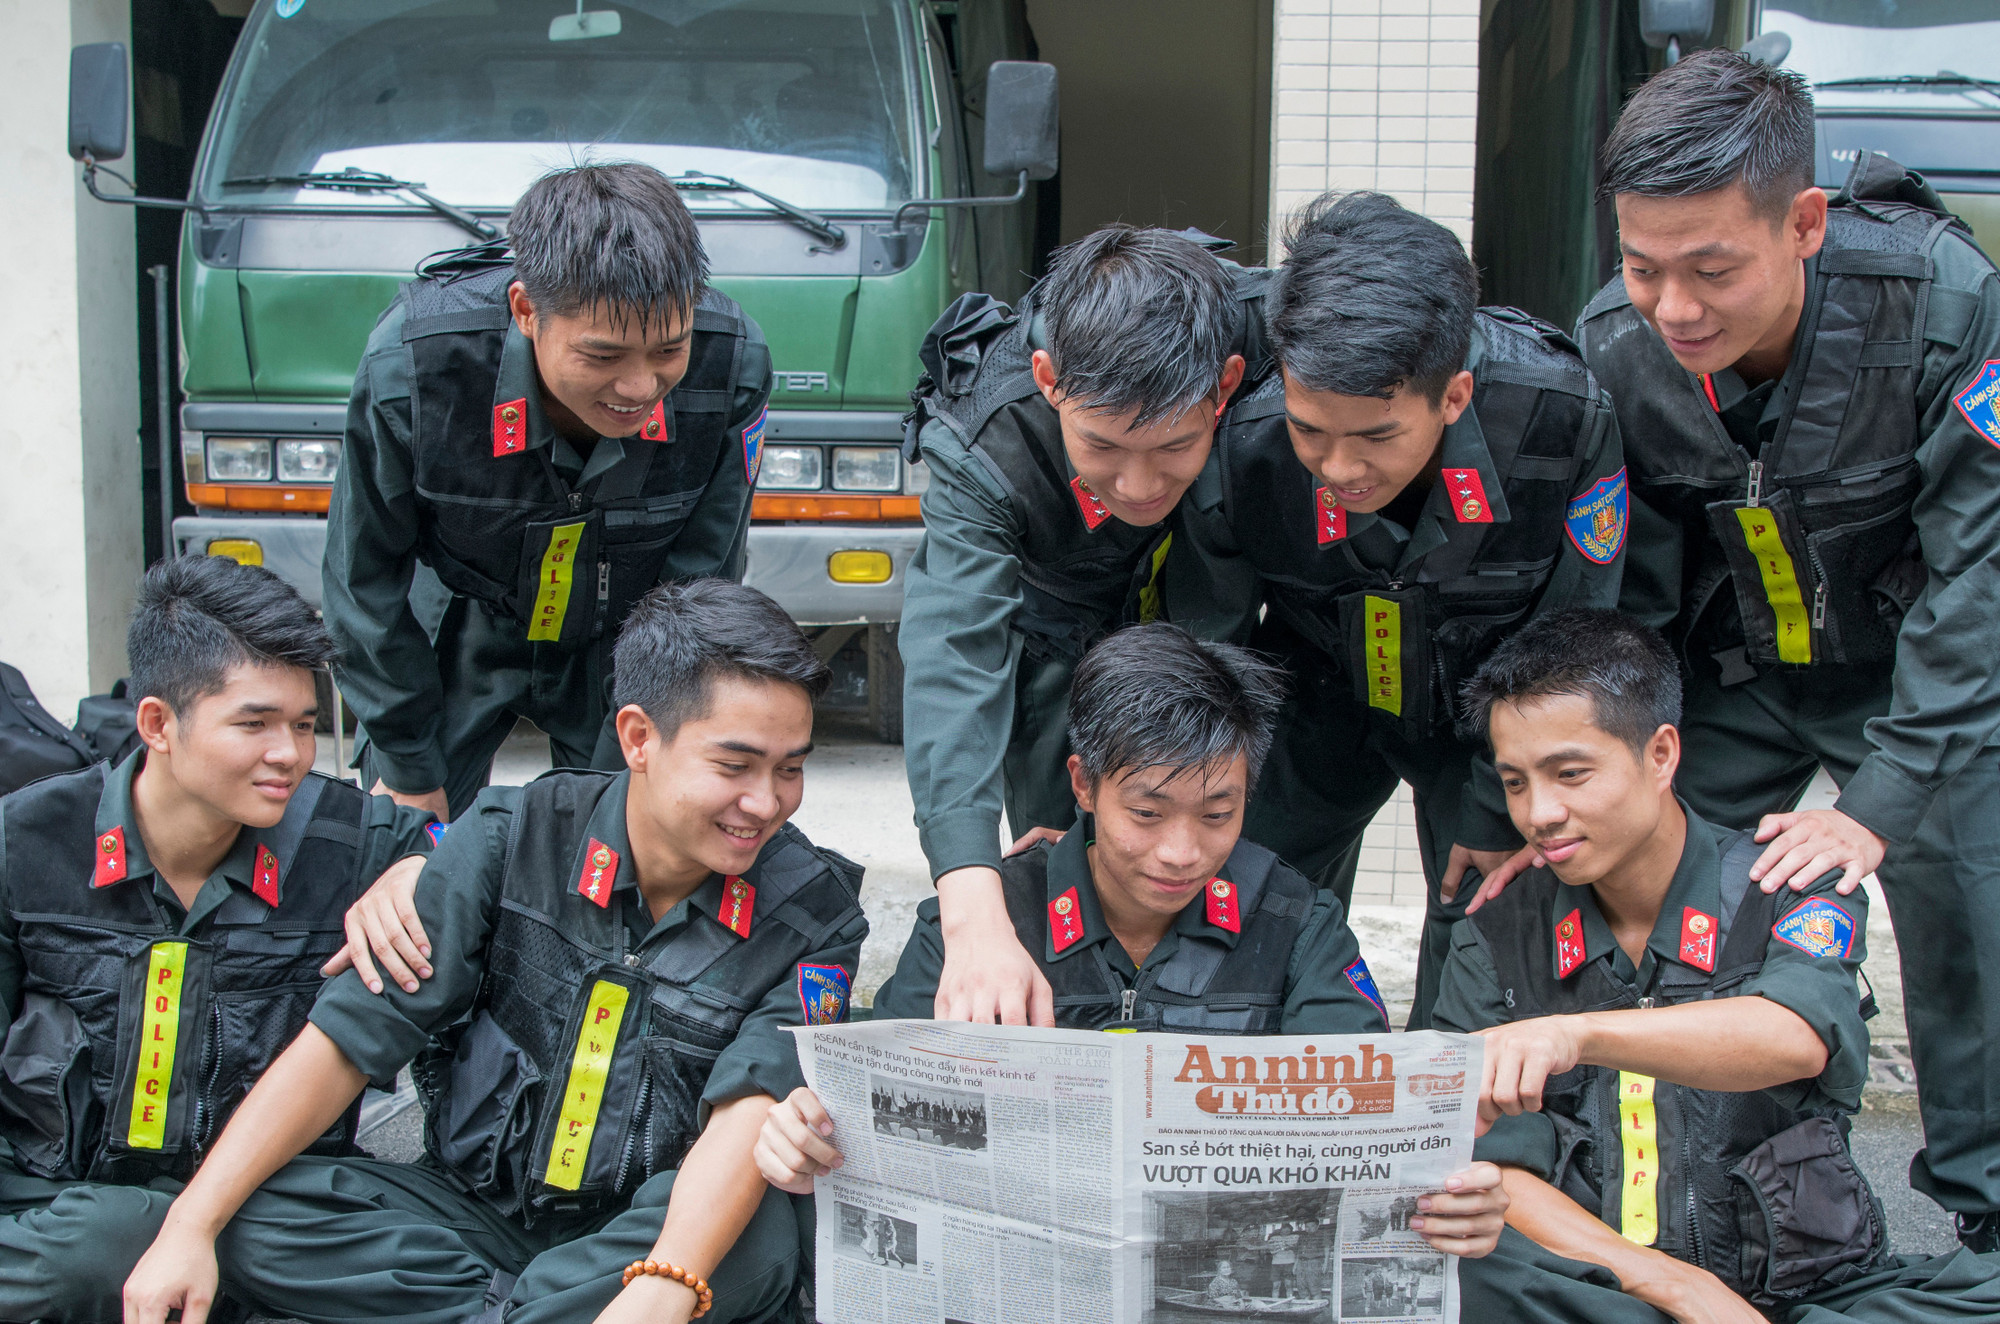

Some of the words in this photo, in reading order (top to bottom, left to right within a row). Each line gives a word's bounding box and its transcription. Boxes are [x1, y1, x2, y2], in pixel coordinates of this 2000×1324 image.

[1567, 504, 1592, 520] CẢNH
[1591, 496, 1606, 512] SÁT
[1375, 611, 1392, 697] POLICE
[1778, 915, 1803, 933] CẢNH
[1803, 909, 1820, 920] SÁT
[804, 969, 827, 986] CẢNH
[824, 978, 837, 993] SÁT
[142, 968, 172, 1122] POLICE
[814, 1032, 846, 1047] ASEAN
[848, 1041, 865, 1052] cần
[867, 1046, 882, 1058] tập
[885, 1051, 911, 1066] trung
[914, 1055, 936, 1069] thúc
[938, 1059, 956, 1073] đẩy
[959, 1064, 978, 1075] liên
[980, 1065, 997, 1078] kết
[1000, 1069, 1021, 1081] kinh
[1025, 1071, 1036, 1082] tế
[814, 1043, 832, 1056] khu
[834, 1051, 849, 1061] vực
[852, 1054, 863, 1065] và
[866, 1057, 881, 1069] tận
[883, 1063, 908, 1077] dụng
[910, 1068, 934, 1082] công
[936, 1073, 961, 1085] nghệ
[964, 1076, 983, 1088] mới
[1144, 1044, 1153, 1119] www.anninhthudo.vn
[1302, 1129, 1321, 1137] VÙNG
[1378, 1126, 1406, 1135] CHƯƠNG
[1143, 1141, 1175, 1156] San
[1180, 1140, 1200, 1156] sẻ
[1205, 1142, 1234, 1157] bớt
[1239, 1143, 1281, 1161] thiệt
[1286, 1144, 1316, 1161] hại,
[1321, 1143, 1363, 1159] cùng
[1368, 1139, 1416, 1157] người
[1420, 1136, 1451, 1151] dân
[1142, 1164, 1208, 1188] VƯỢT
[1213, 1165, 1263, 1187] QUA
[1269, 1162, 1319, 1184] KHÓ
[1324, 1159, 1391, 1183] KHĂN
